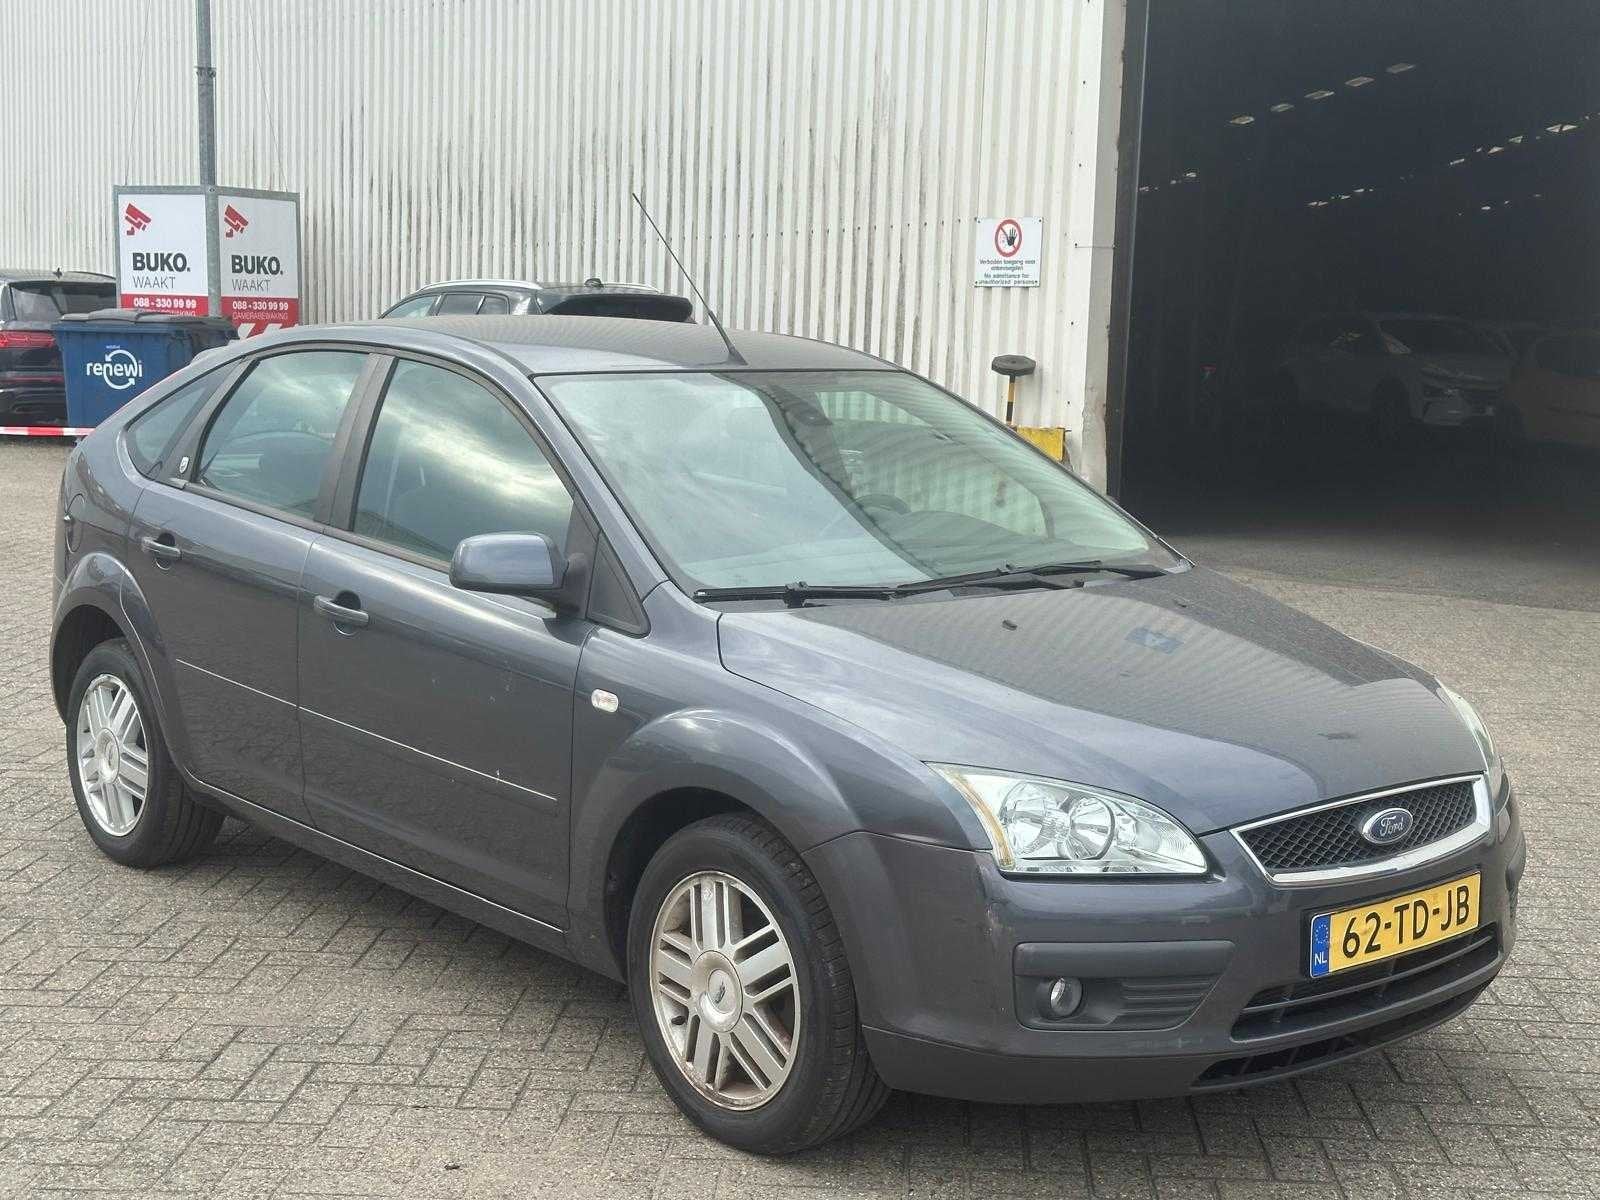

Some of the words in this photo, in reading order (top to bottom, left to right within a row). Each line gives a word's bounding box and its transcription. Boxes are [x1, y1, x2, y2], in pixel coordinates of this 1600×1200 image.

[132, 252, 191, 272] BUKO.
[231, 254, 284, 275] BUKO.
[132, 276, 176, 290] WAAKT
[231, 279, 271, 292] WAAKT
[133, 297, 150, 307] 088
[155, 298, 172, 308] 330
[173, 298, 185, 309] 99
[185, 298, 197, 309] 99
[232, 300, 247, 310] 088
[252, 301, 267, 310] 330
[268, 301, 278, 311] 99
[279, 302, 289, 311] 99
[86, 359, 143, 379] renewi
[1379, 815, 1404, 836] Ford
[1342, 885, 1470, 959] 62-TD-JB
[1314, 951, 1328, 966] NL
